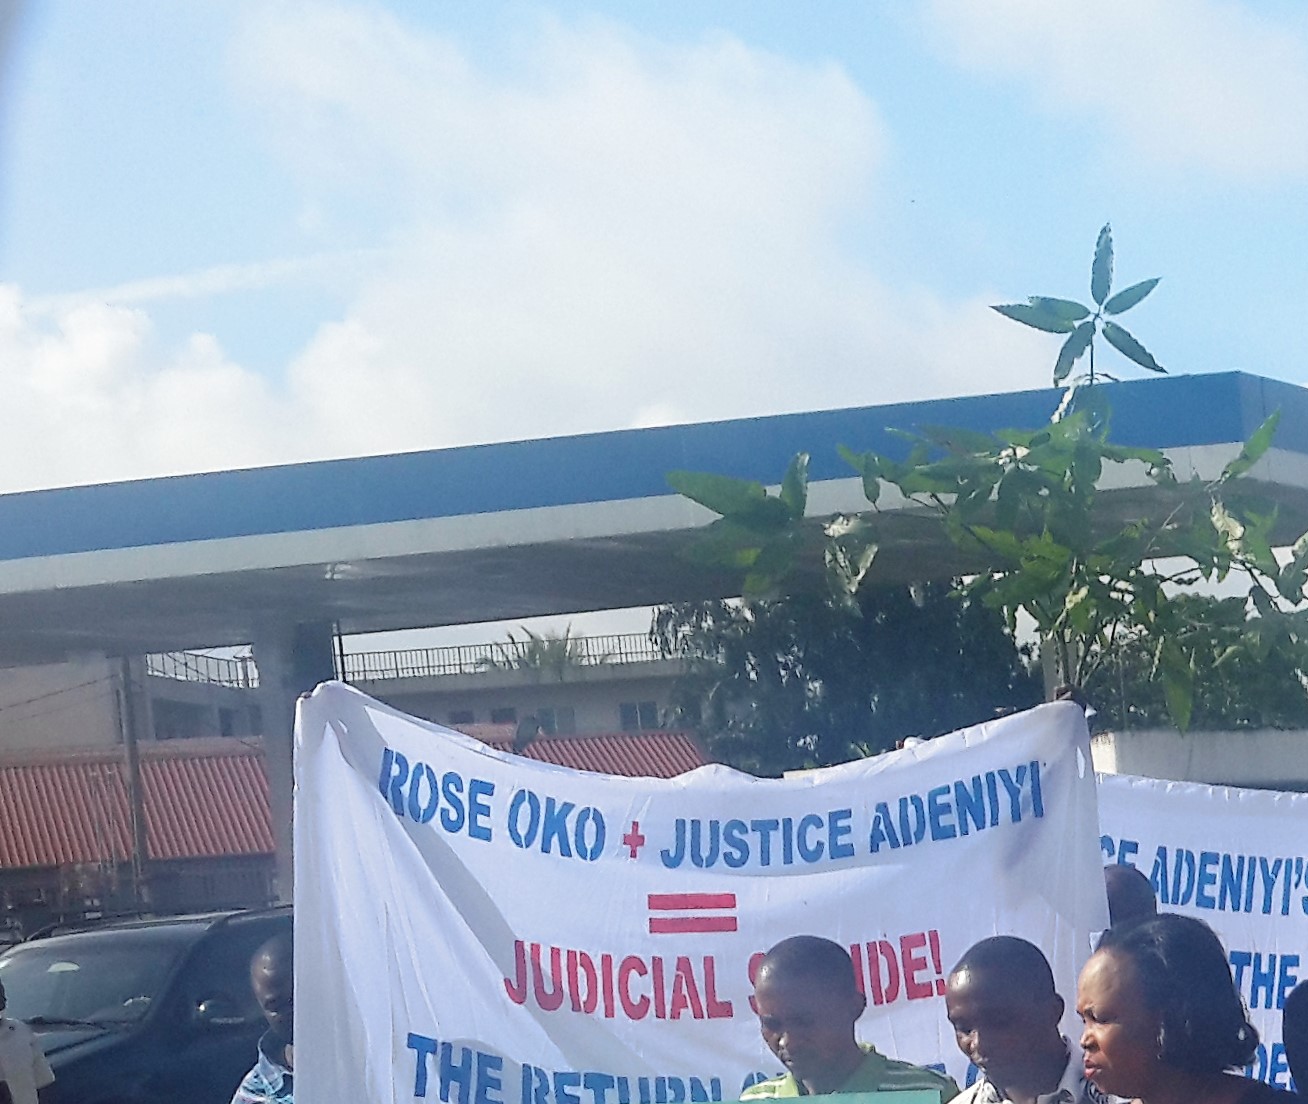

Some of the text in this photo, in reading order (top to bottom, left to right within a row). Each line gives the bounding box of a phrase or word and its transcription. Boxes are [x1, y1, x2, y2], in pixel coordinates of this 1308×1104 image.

[378, 744, 494, 843] ROSE
[506, 799, 607, 863] OKO
[659, 808, 855, 870] JUSTICE
[869, 757, 1047, 855] ADENIYI
[503, 939, 735, 1021] JUDICIAL
[1229, 951, 1299, 1010] THE
